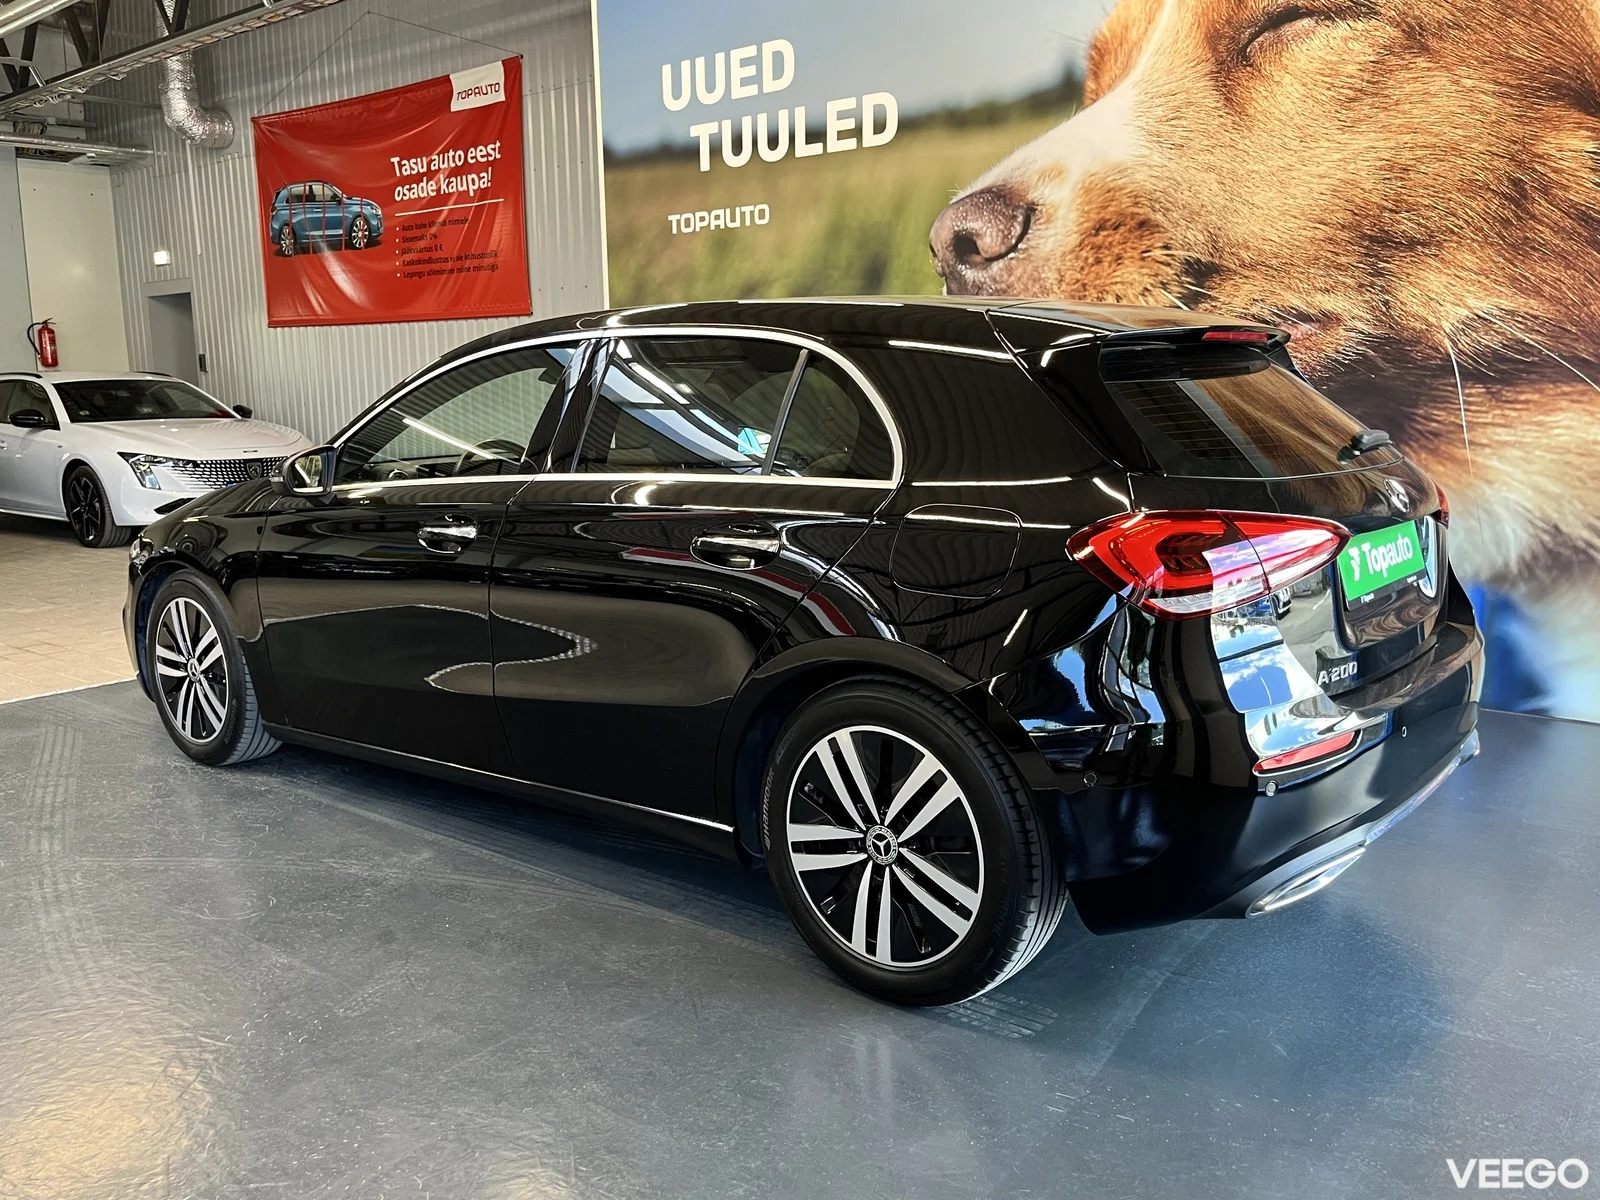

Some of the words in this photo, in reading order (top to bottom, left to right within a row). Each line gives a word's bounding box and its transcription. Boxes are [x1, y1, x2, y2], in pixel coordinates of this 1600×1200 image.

[456, 82, 501, 101] TOPAUTO
[662, 39, 795, 112] UUED
[690, 92, 899, 172] TUULED
[390, 156, 427, 177] Tasu
[430, 149, 464, 171] auto
[467, 140, 501, 164] eest
[394, 177, 437, 201] osade
[440, 167, 492, 197] kaupa!
[668, 203, 770, 235] TOPAUTO
[1361, 533, 1413, 578] Topauto
[1317, 670, 1329, 686] A
[1331, 661, 1358, 682] 200
